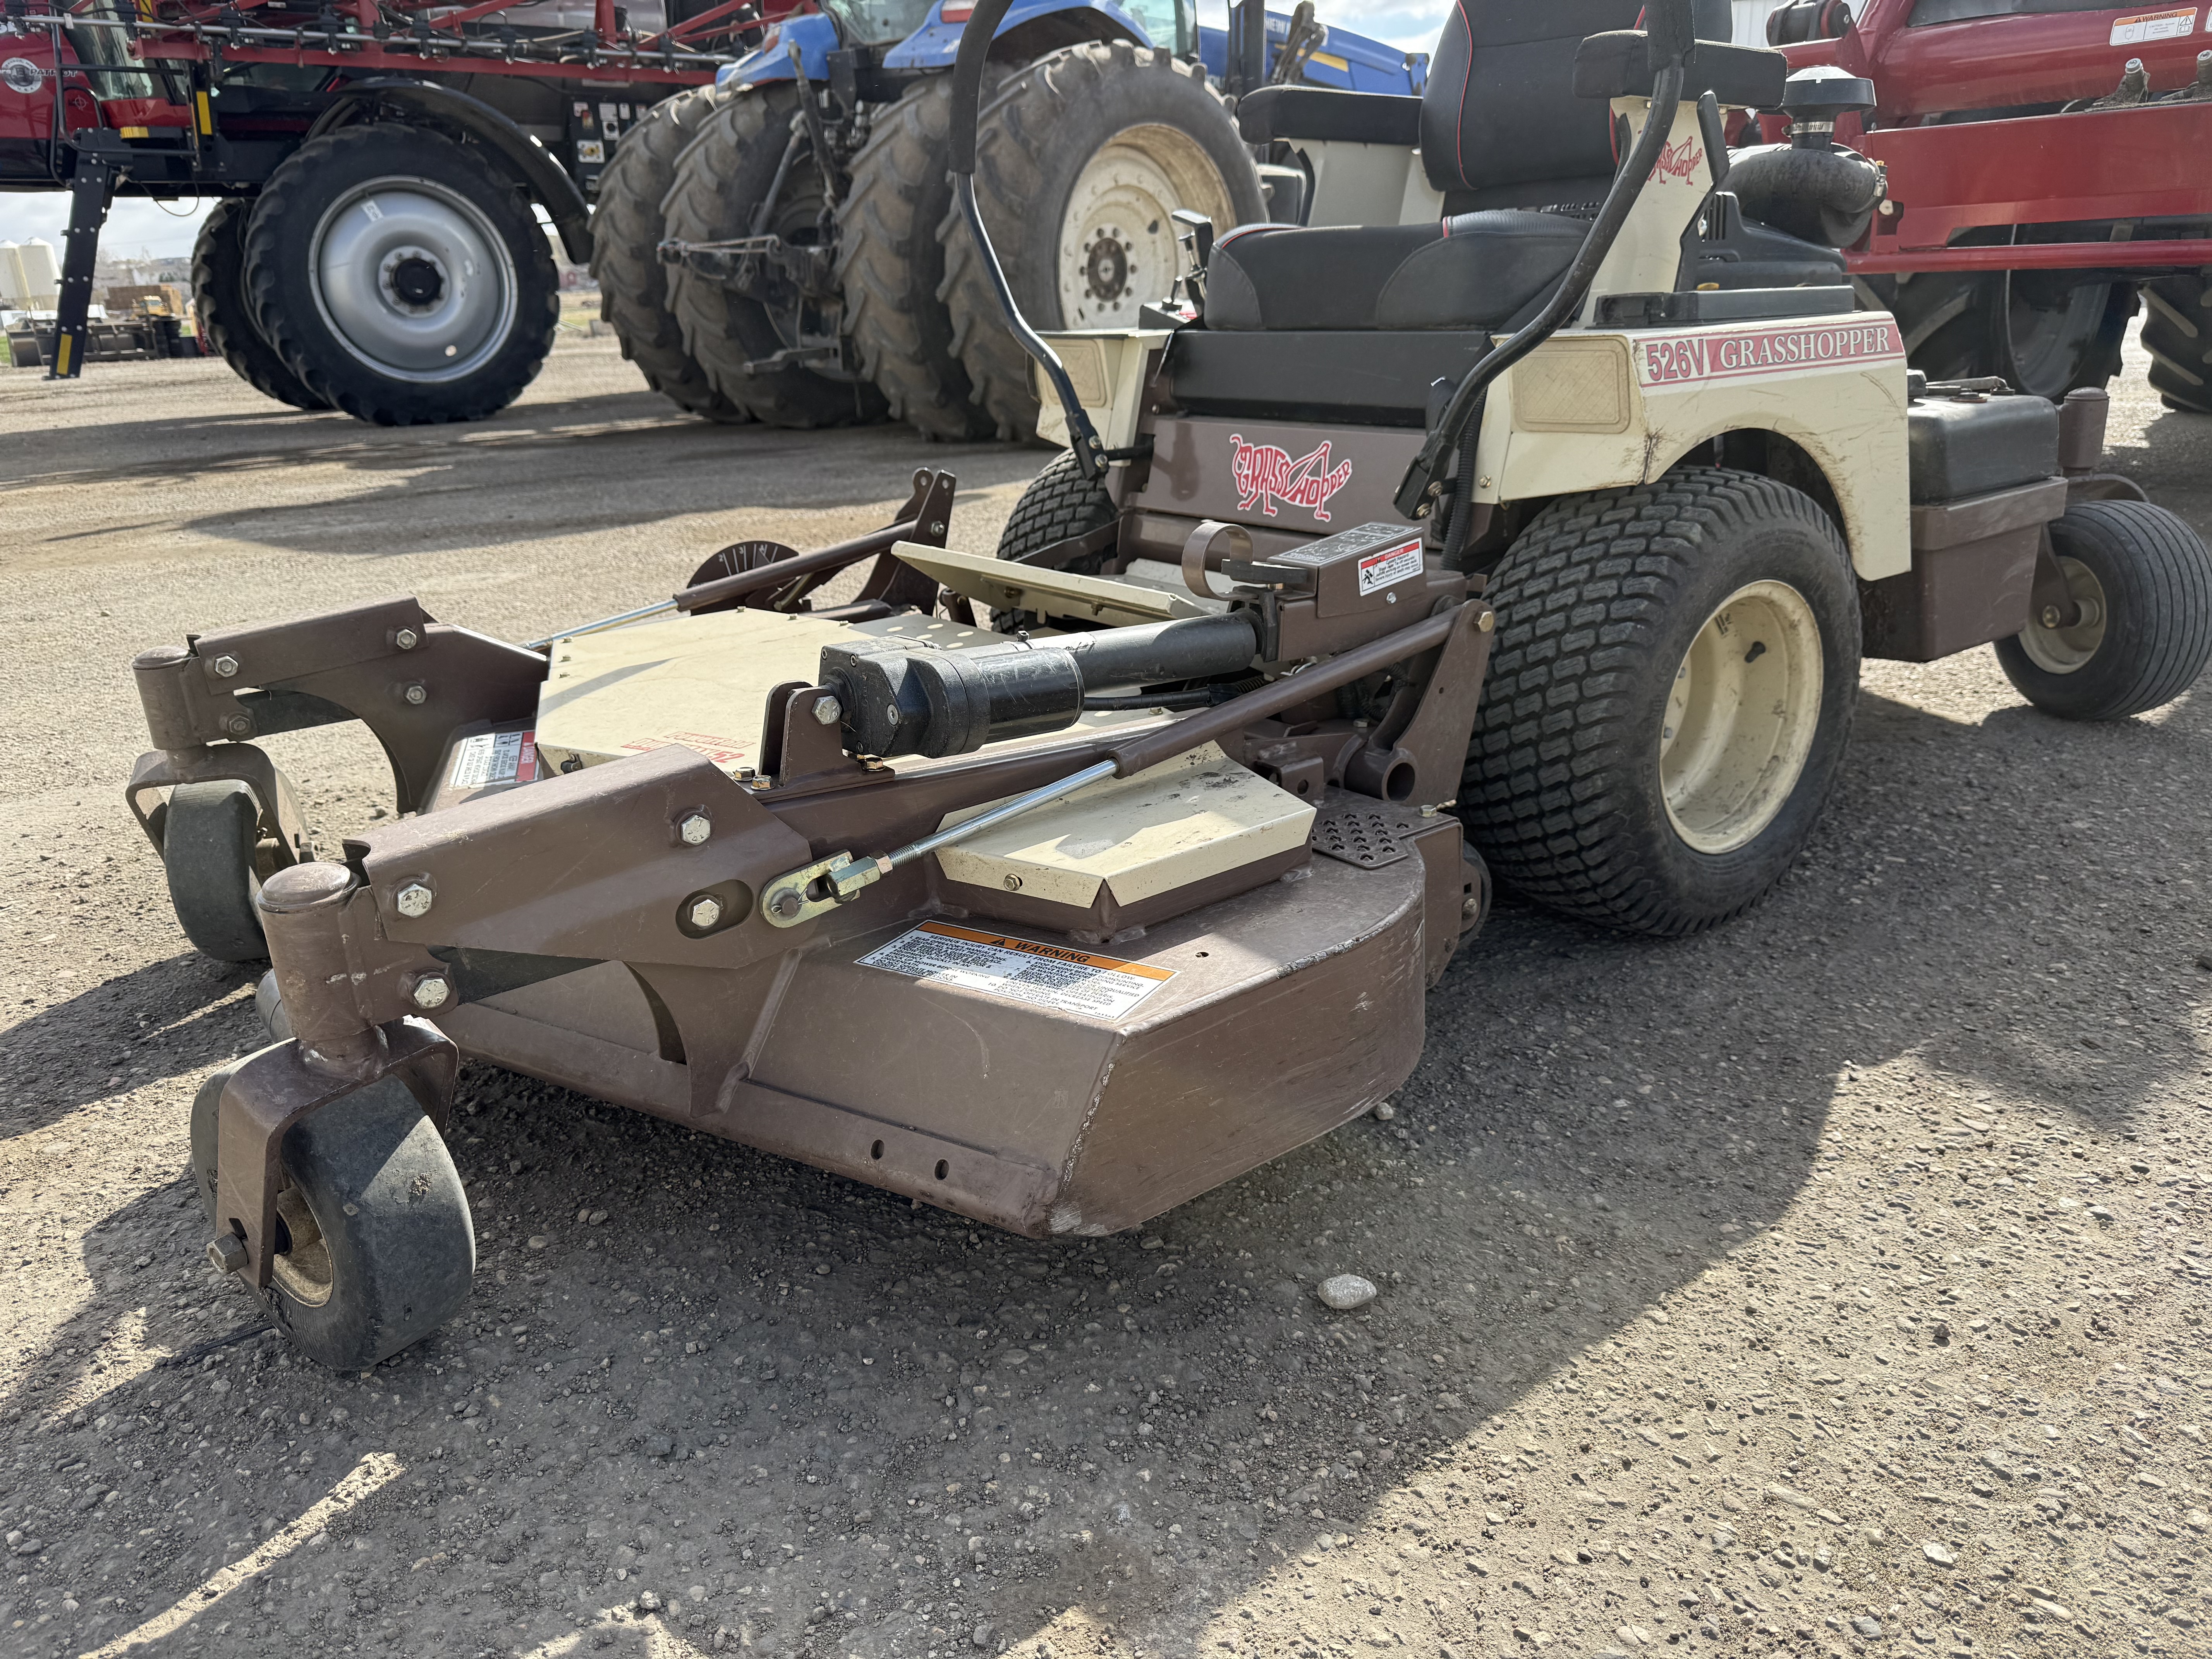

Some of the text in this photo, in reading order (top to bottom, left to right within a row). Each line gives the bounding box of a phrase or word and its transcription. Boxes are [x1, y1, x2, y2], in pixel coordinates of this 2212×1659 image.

[2143, 12, 2177, 22] WARNING
[1647, 326, 1890, 381] 526V GRASSHOPPER
[1384, 548, 1403, 559] DANGER
[709, 751, 745, 763] 52
[893, 949, 927, 957] EQUIPMENT
[928, 935, 961, 943] SERIOUS
[1056, 962, 1090, 970] FAILURE
[1012, 942, 1092, 962] WARNING
[958, 970, 991, 978] WORKING
[1035, 969, 1082, 980] MAINTENANCE
[1032, 979, 1063, 987] MOWING
[1097, 975, 1146, 987] DISMOUNTING.
[1060, 992, 1091, 1001] DECREASE
[1065, 989, 1103, 1000] OPERATING
[1096, 986, 1140, 997] UNQUALIFIED
